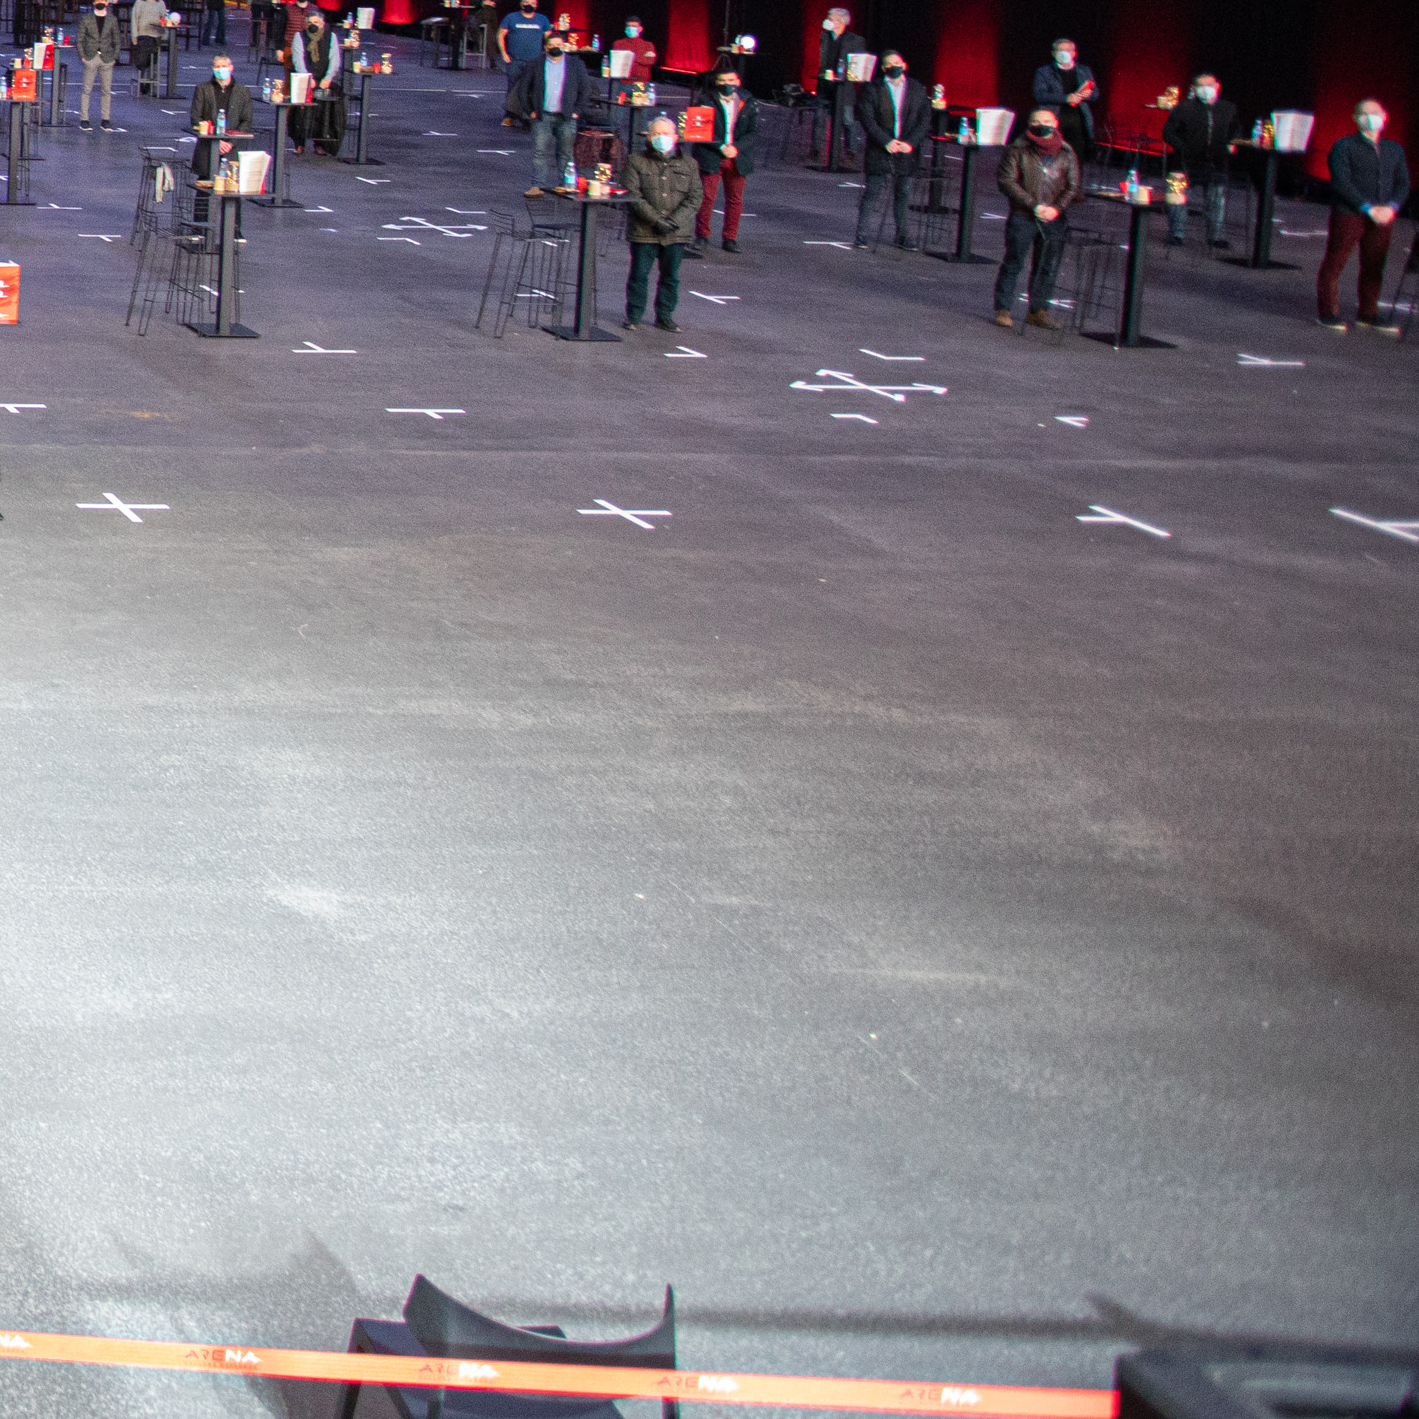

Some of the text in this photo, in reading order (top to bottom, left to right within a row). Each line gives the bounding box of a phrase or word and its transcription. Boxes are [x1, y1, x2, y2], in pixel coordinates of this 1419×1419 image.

[183, 1348, 262, 1364] ARENA
[418, 1361, 500, 1380] ARENA
[656, 1374, 740, 1395] ARENA
